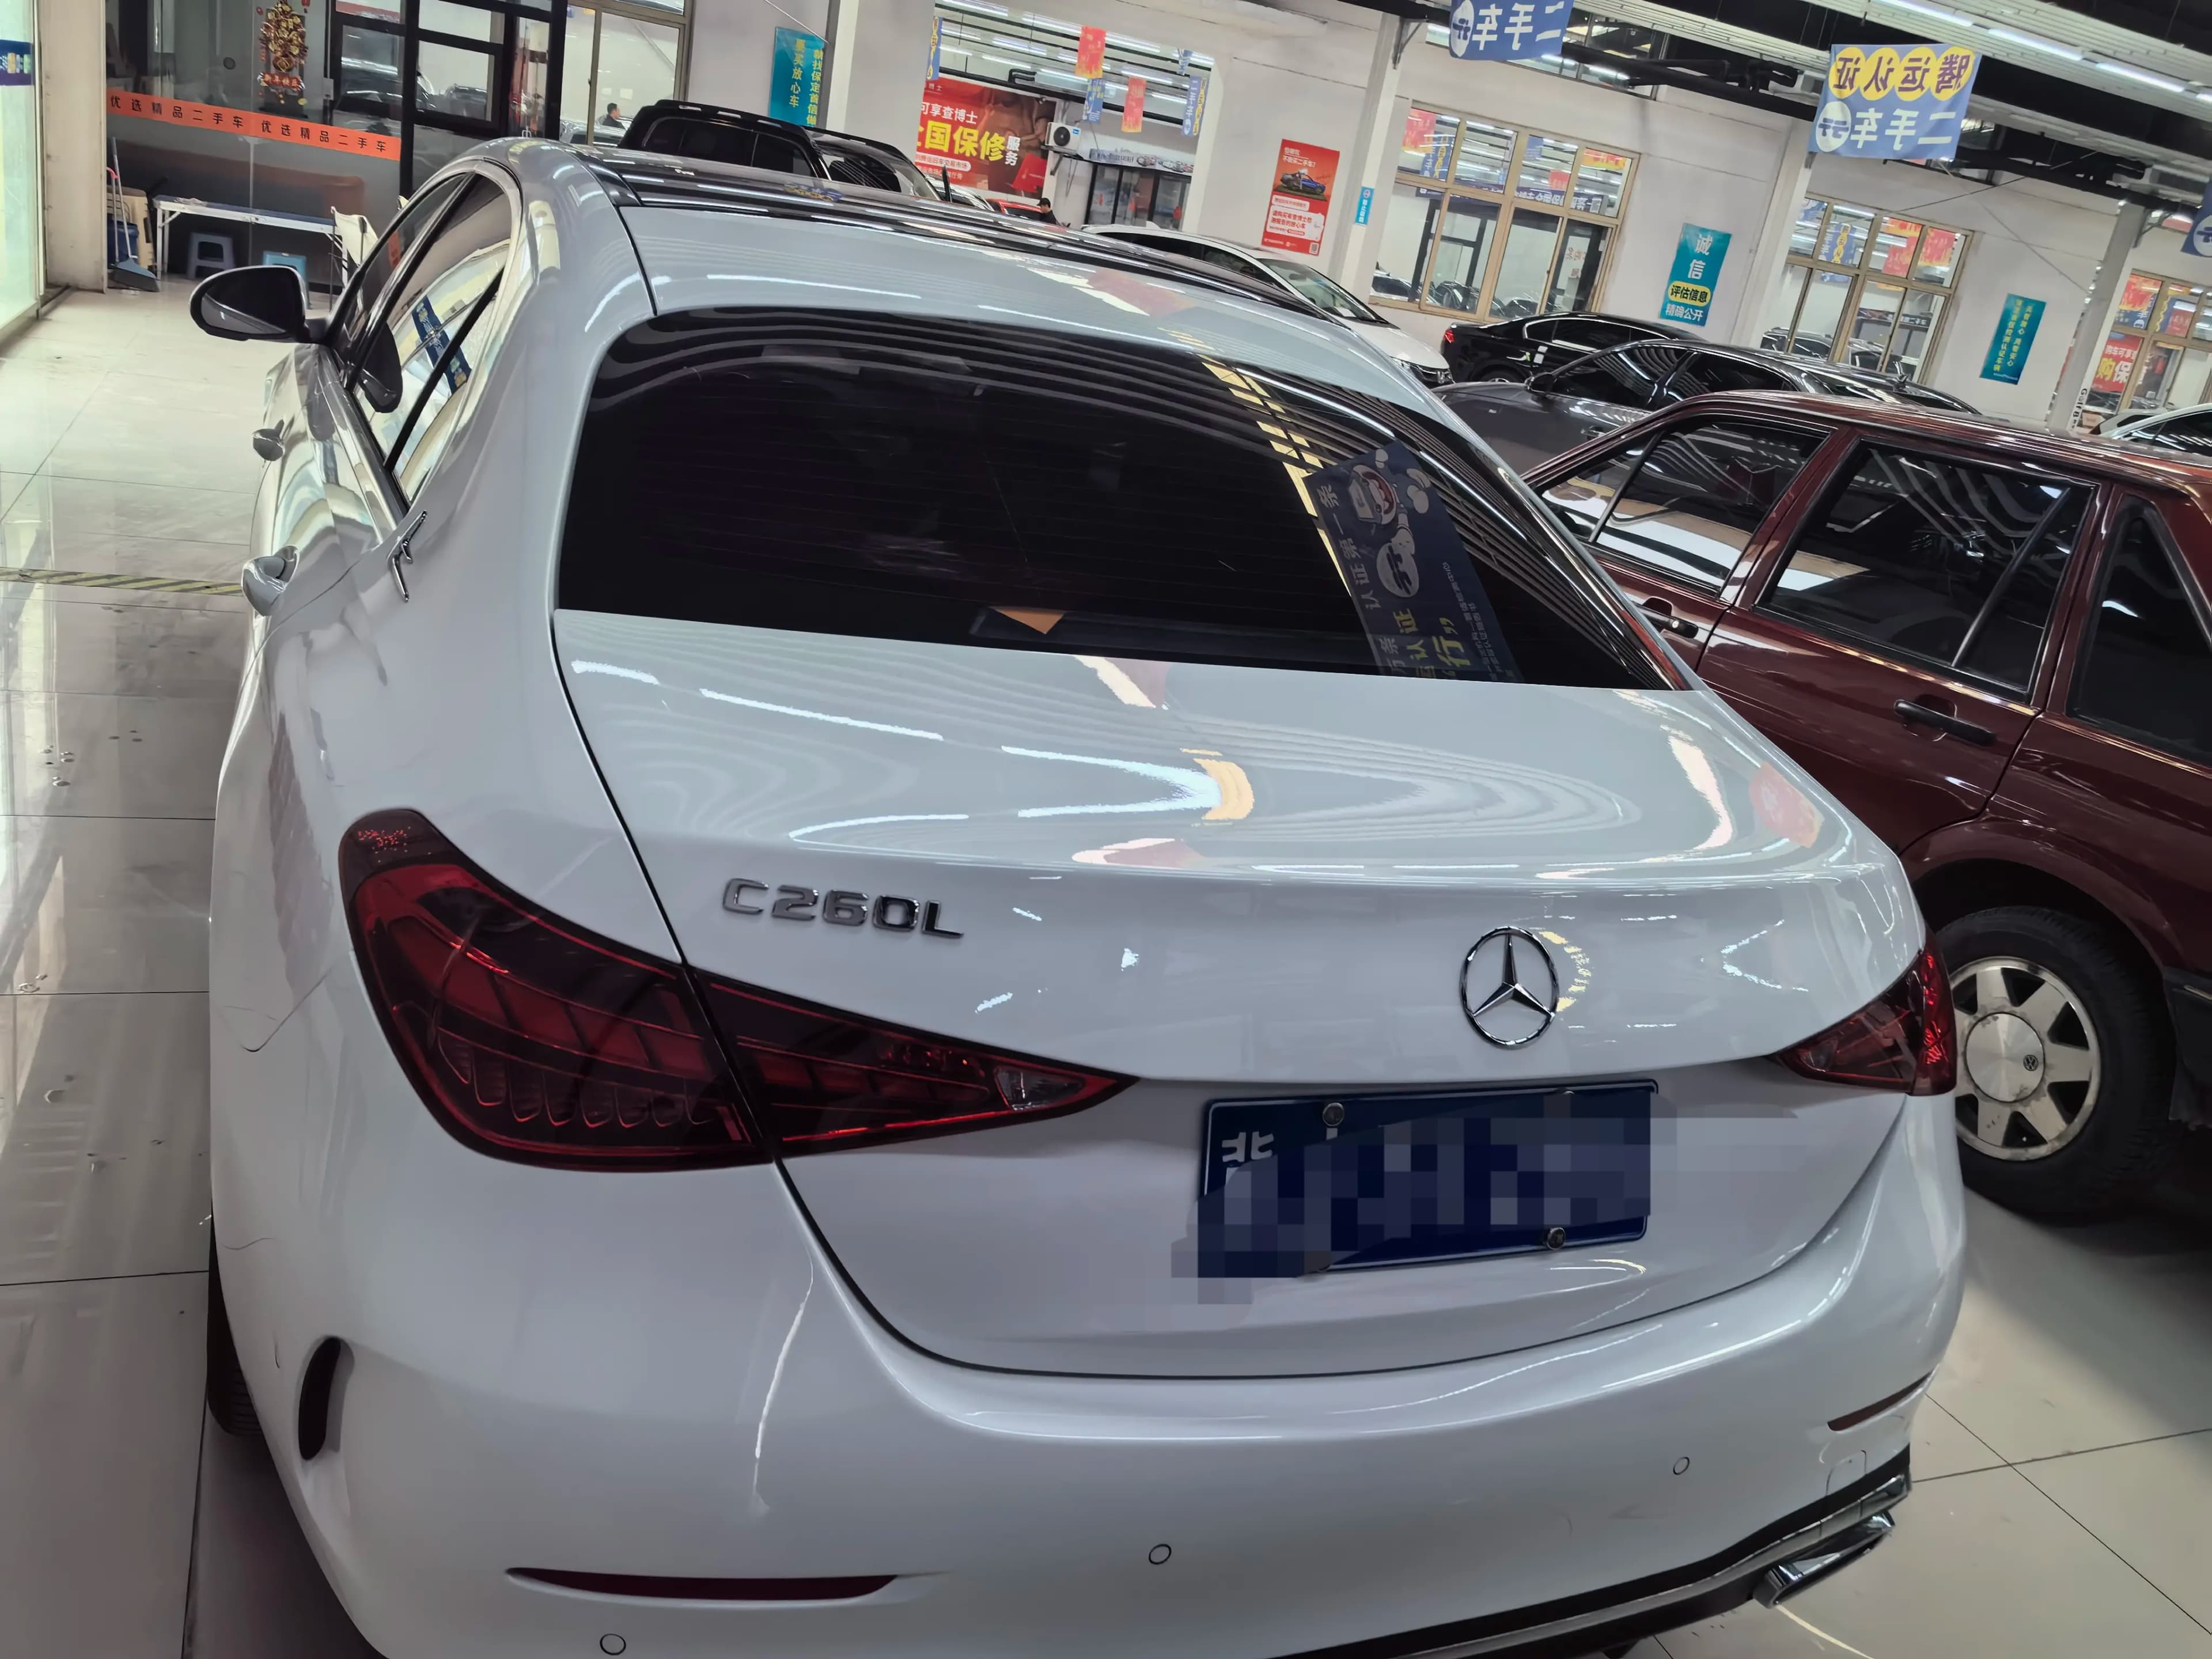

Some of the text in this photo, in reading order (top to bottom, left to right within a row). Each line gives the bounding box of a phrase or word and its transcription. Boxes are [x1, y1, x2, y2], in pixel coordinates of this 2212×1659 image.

[111, 94, 243, 128] 优选精品二手车
[262, 120, 386, 153] 优选精品二手车
[917, 120, 1006, 162] 国保修
[1005, 135, 1021, 166] 服务
[1687, 233, 1714, 280] 诚信
[1671, 285, 1709, 303] 评估信息
[722, 877, 964, 939] C260L
